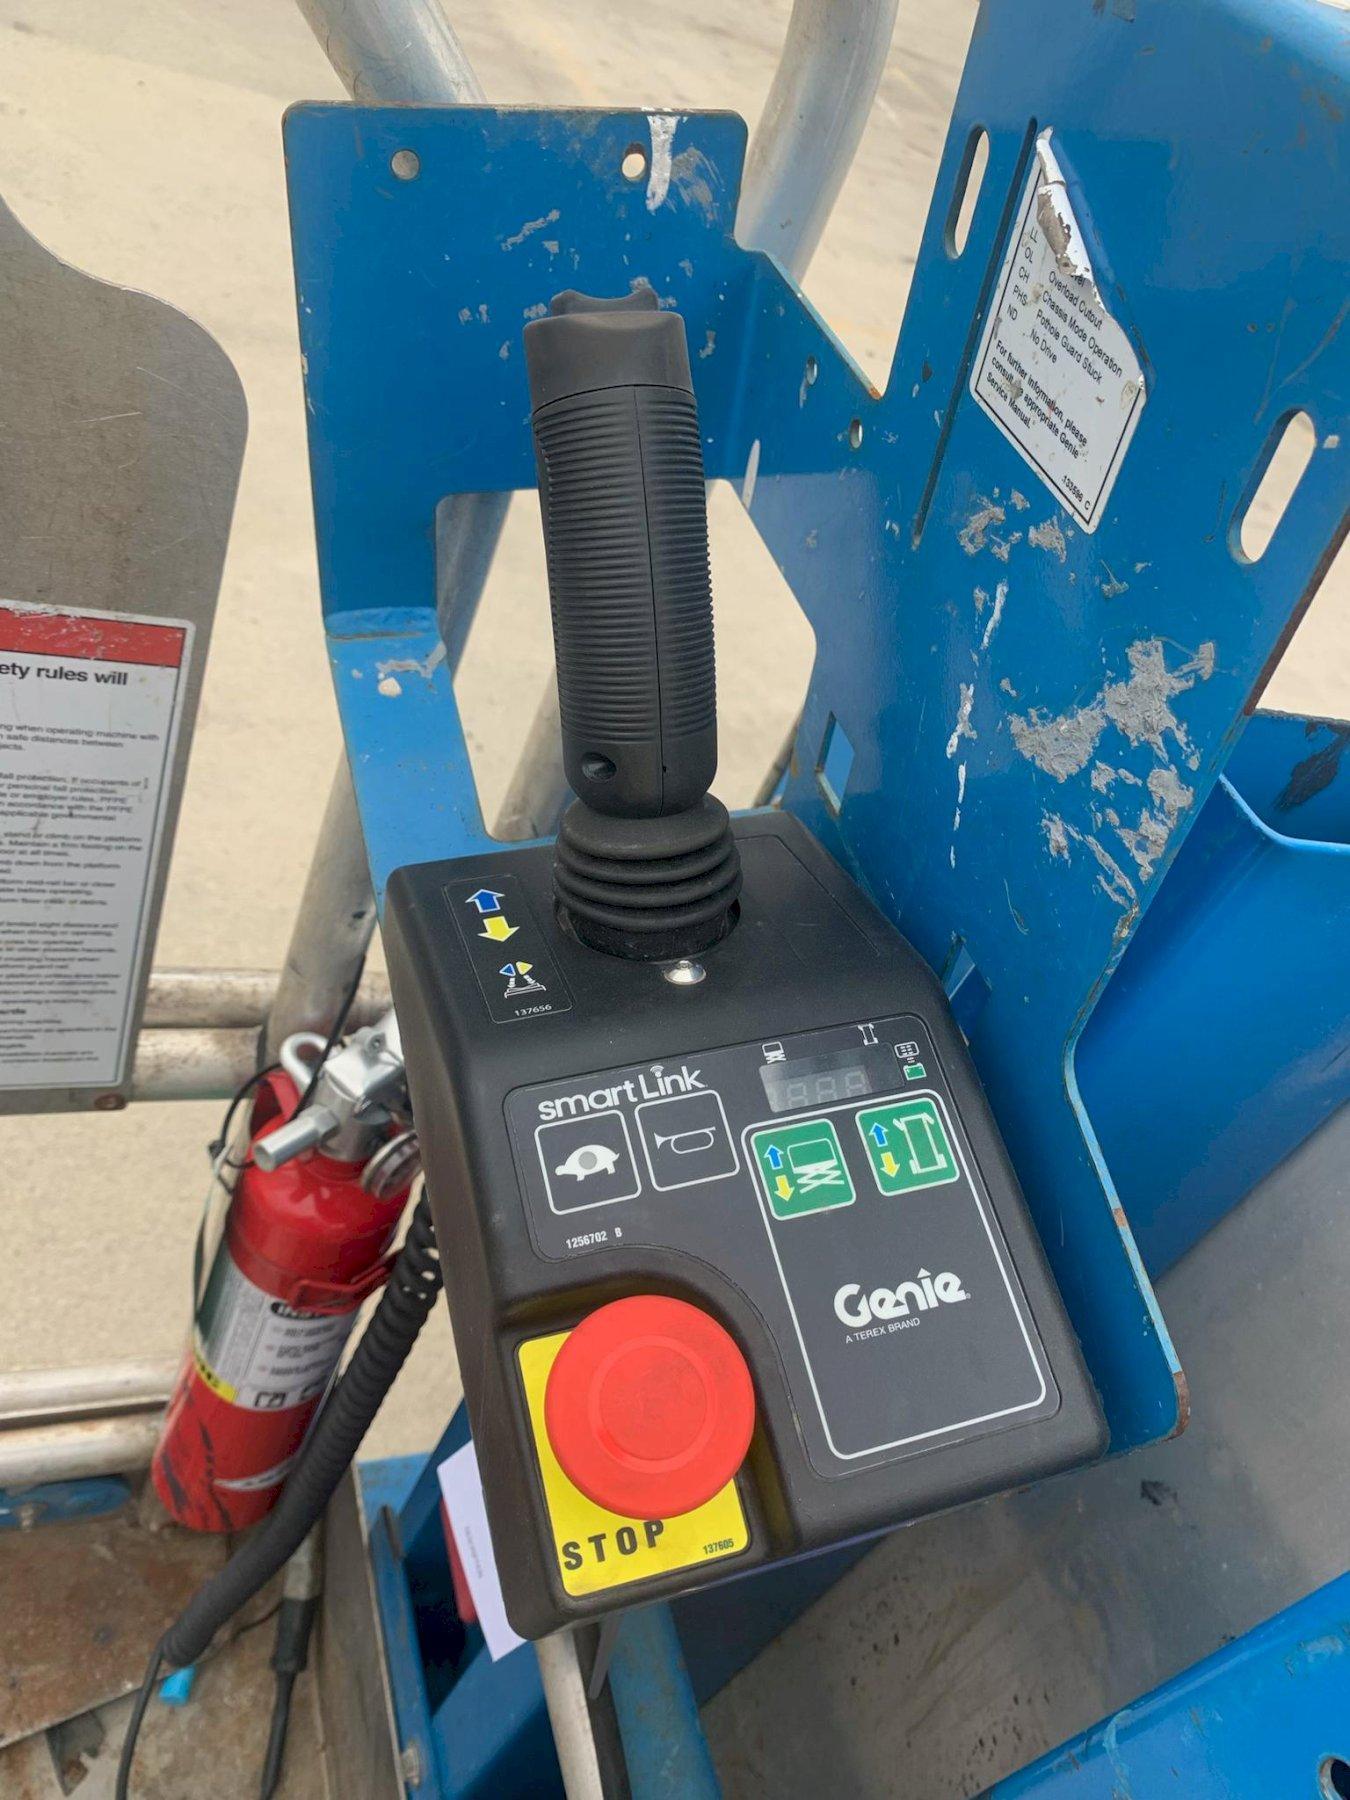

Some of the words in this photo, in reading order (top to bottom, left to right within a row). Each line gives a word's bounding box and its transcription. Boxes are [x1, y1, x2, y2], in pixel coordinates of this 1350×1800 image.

[1030, 227, 1038, 243] LL
[1024, 247, 1034, 264] OL
[1049, 271, 1082, 306] Overload
[1079, 301, 1103, 331] Cutout
[1006, 304, 1018, 321] ND
[1030, 328, 1040, 345] No
[1040, 340, 1058, 364] Drive
[1013, 285, 1028, 306] PHS
[1036, 309, 1060, 340] Pothole
[1061, 335, 1082, 363] Guard
[1082, 357, 1102, 384] Stuck
[1018, 266, 1030, 283] CH
[1042, 290, 1068, 323] Chassis
[1067, 317, 1088, 342] Mode
[1088, 336, 1123, 379] Operation
[987, 371, 1008, 402] Service
[1008, 396, 1031, 430] Manual.
[992, 356, 1014, 385] consult
[1023, 393, 1059, 437] appropriate
[1059, 432, 1080, 459] Genie
[996, 340, 1007, 356] For
[1007, 352, 1028, 380] further
[1027, 374, 1064, 422] information,
[1064, 416, 1088, 447] please
[1084, 500, 1091, 511] C
[0, 663, 30, 679] ety
[37, 667, 88, 682] rules
[95, 672, 128, 685] will
[6, 734, 29, 742] safe
[31, 735, 78, 745] distances
[16, 724, 43, 732] when
[46, 728, 93, 737] operating
[514, 1004, 552, 1017] 137656
[566, 1231, 608, 1250] 1256702
[614, 1227, 623, 1238] B
[833, 1267, 967, 1328] Genie
[845, 1335, 853, 1344] A
[853, 1326, 887, 1341] TEREX
[888, 1317, 920, 1333] BRAND
[562, 1520, 664, 1571] STOP
[703, 1538, 735, 1555] 137605
